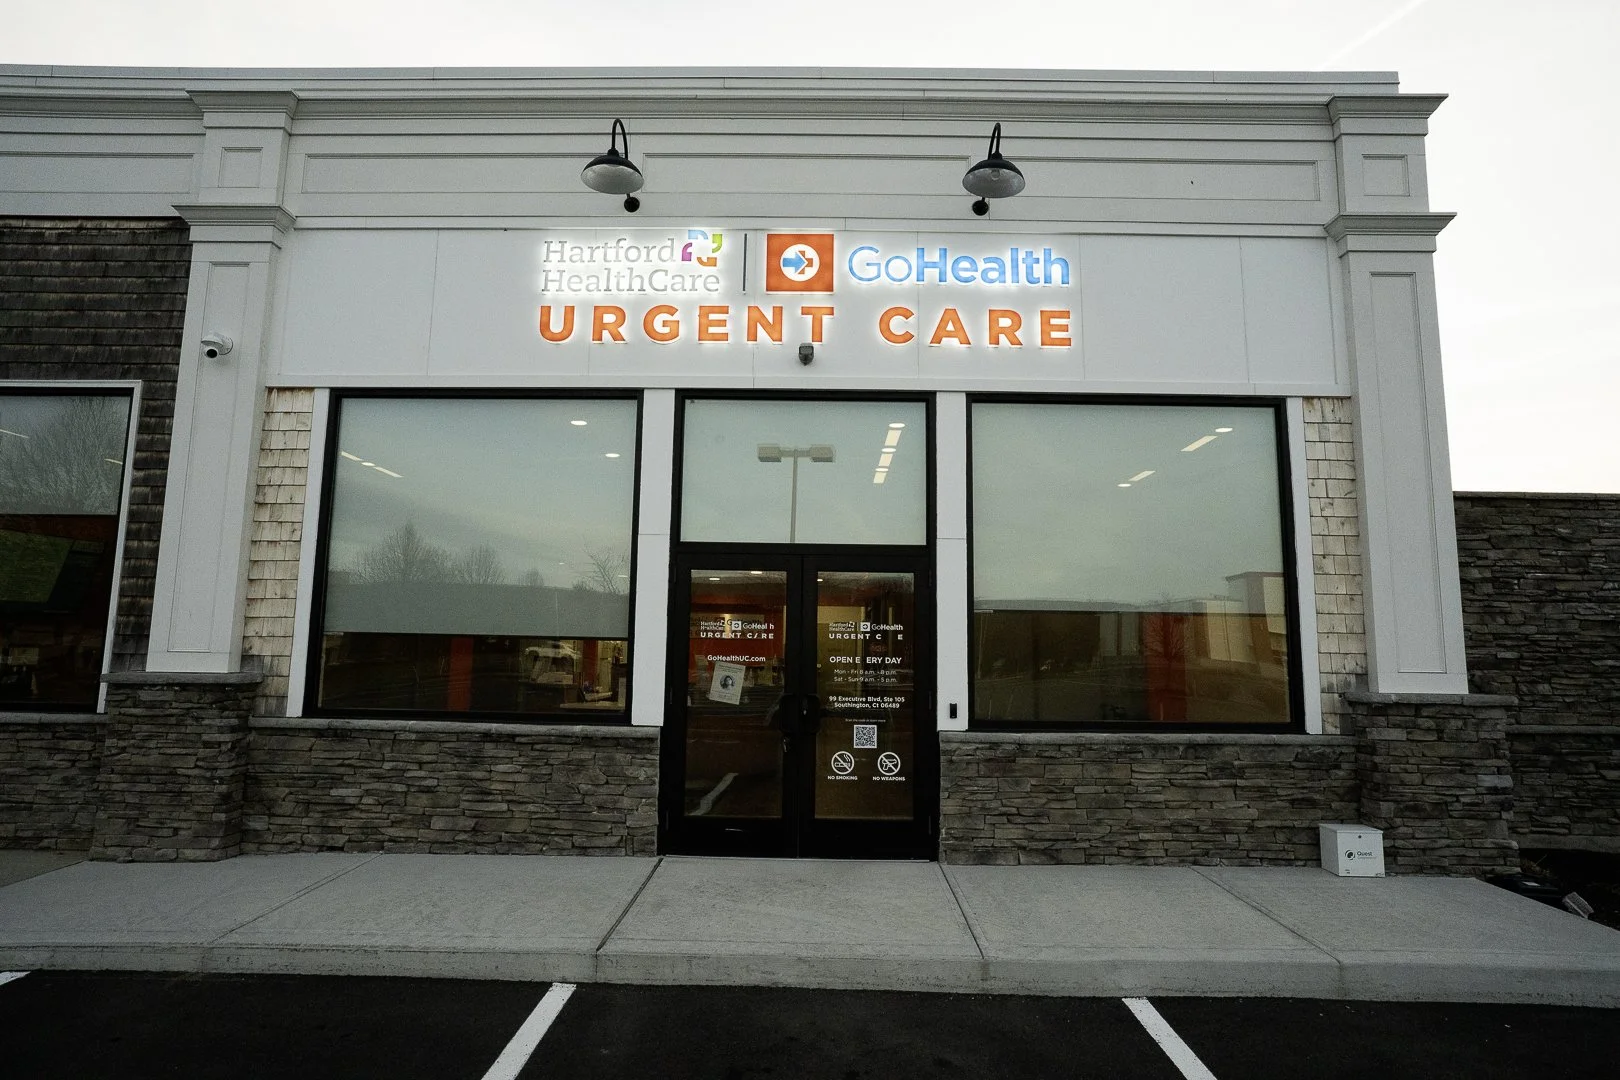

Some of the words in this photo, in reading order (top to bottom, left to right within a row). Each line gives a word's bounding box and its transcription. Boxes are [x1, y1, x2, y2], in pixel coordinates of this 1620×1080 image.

[542, 237, 676, 264] Hartford
[847, 245, 1070, 286] GoHealth
[541, 267, 720, 293] HealthCare
[539, 304, 835, 345] URGENT
[878, 306, 1072, 347] CARE
[743, 622, 774, 630] GoHealh
[855, 656, 883, 664] EERY
